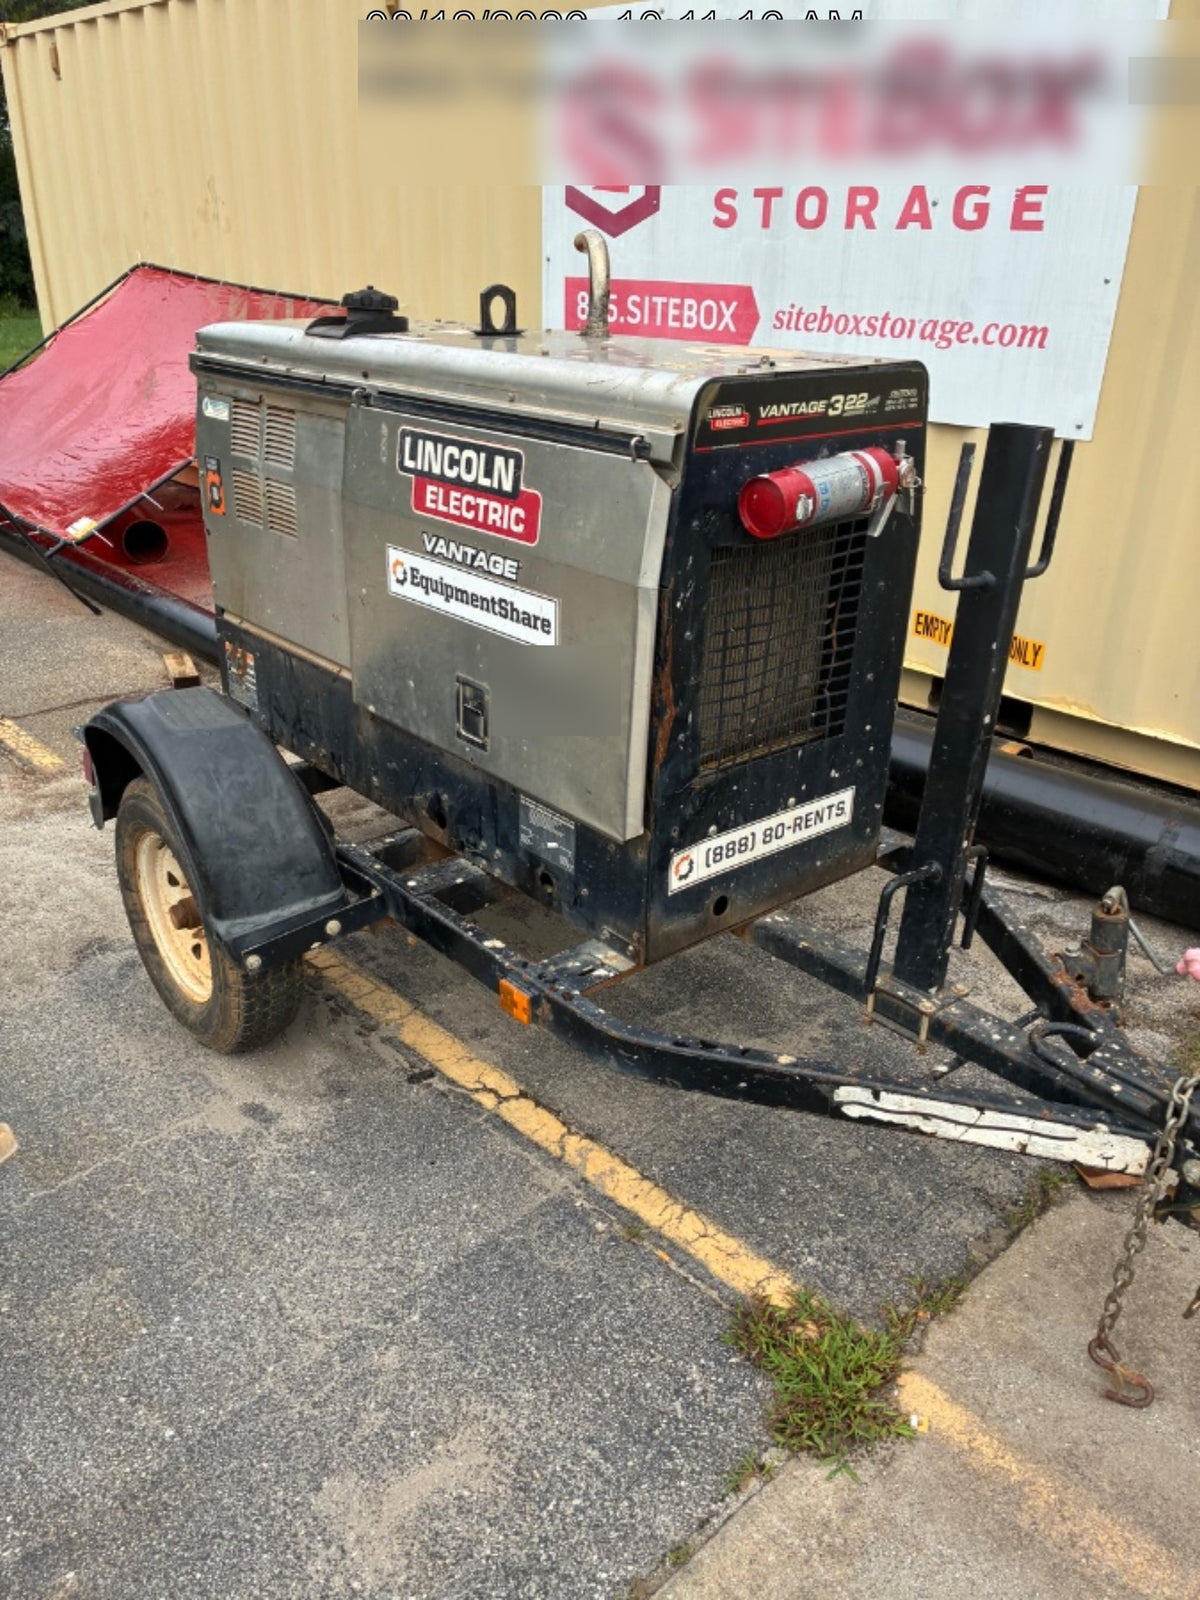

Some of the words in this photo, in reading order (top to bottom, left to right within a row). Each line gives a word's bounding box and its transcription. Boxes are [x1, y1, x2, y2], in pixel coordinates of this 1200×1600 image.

[712, 184, 1049, 231] STORAGE
[576, 290, 739, 333] 85.SITEBOX
[772, 303, 1050, 350] siteboxstorage.com
[758, 399, 827, 419] VANTAGE
[828, 392, 869, 417] 322
[402, 435, 516, 493] LINCOLN
[424, 484, 526, 533] ELECTRIC
[422, 532, 520, 581] VANTAGE
[409, 566, 552, 635] EquipmentShare
[914, 612, 952, 645] EMPTY
[1009, 636, 1043, 668] ONLY
[704, 831, 757, 868] (888)
[762, 799, 847, 845] 80-RENTS
